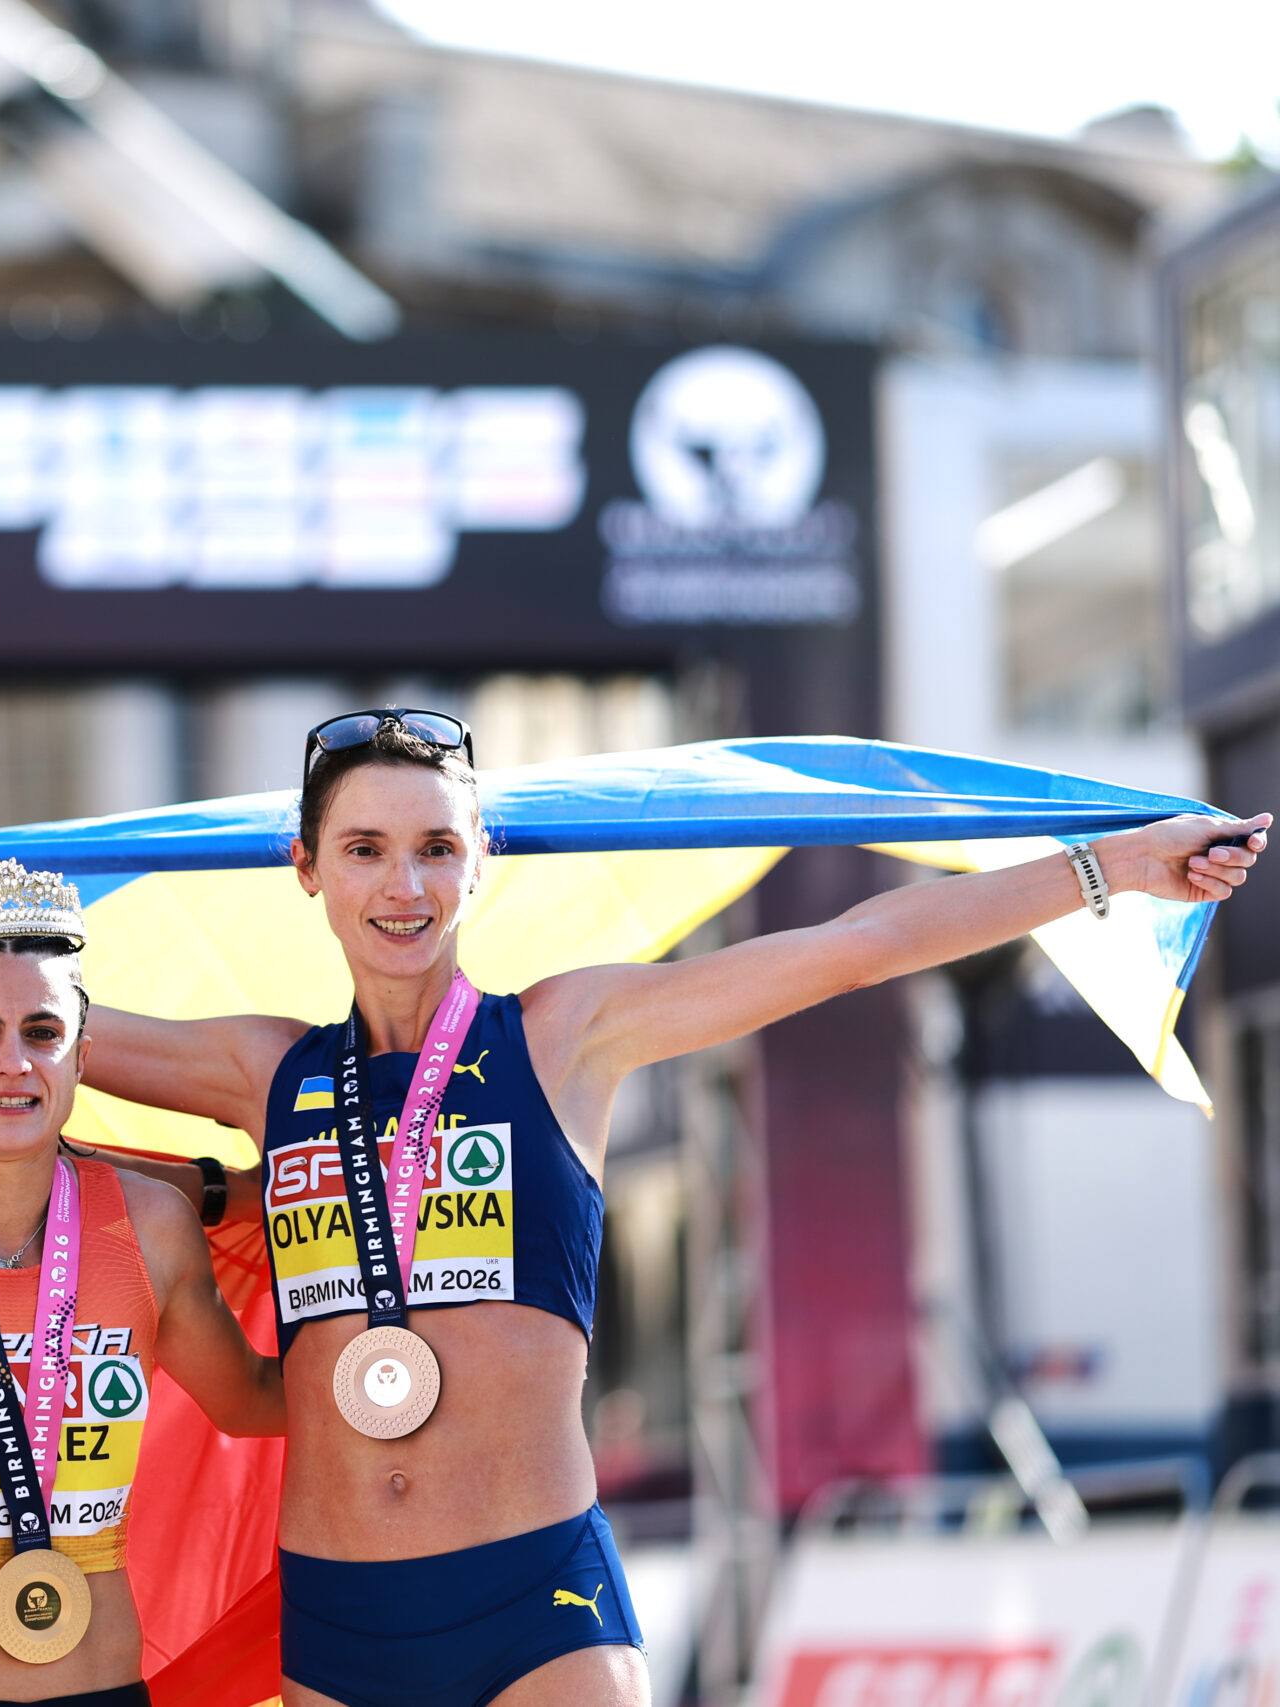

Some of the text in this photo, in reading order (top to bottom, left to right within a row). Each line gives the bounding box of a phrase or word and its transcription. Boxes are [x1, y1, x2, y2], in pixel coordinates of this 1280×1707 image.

[274, 1145, 437, 1198] SP
[346, 1116, 387, 1276] BIRMINGHAM
[391, 1108, 427, 1256] RMINGHAM
[272, 1192, 505, 1249] OLYAVSKA
[440, 1269, 502, 1290] 2026
[32, 1314, 62, 1487] IRMINGHAM
[78, 1498, 123, 1524] 2026
